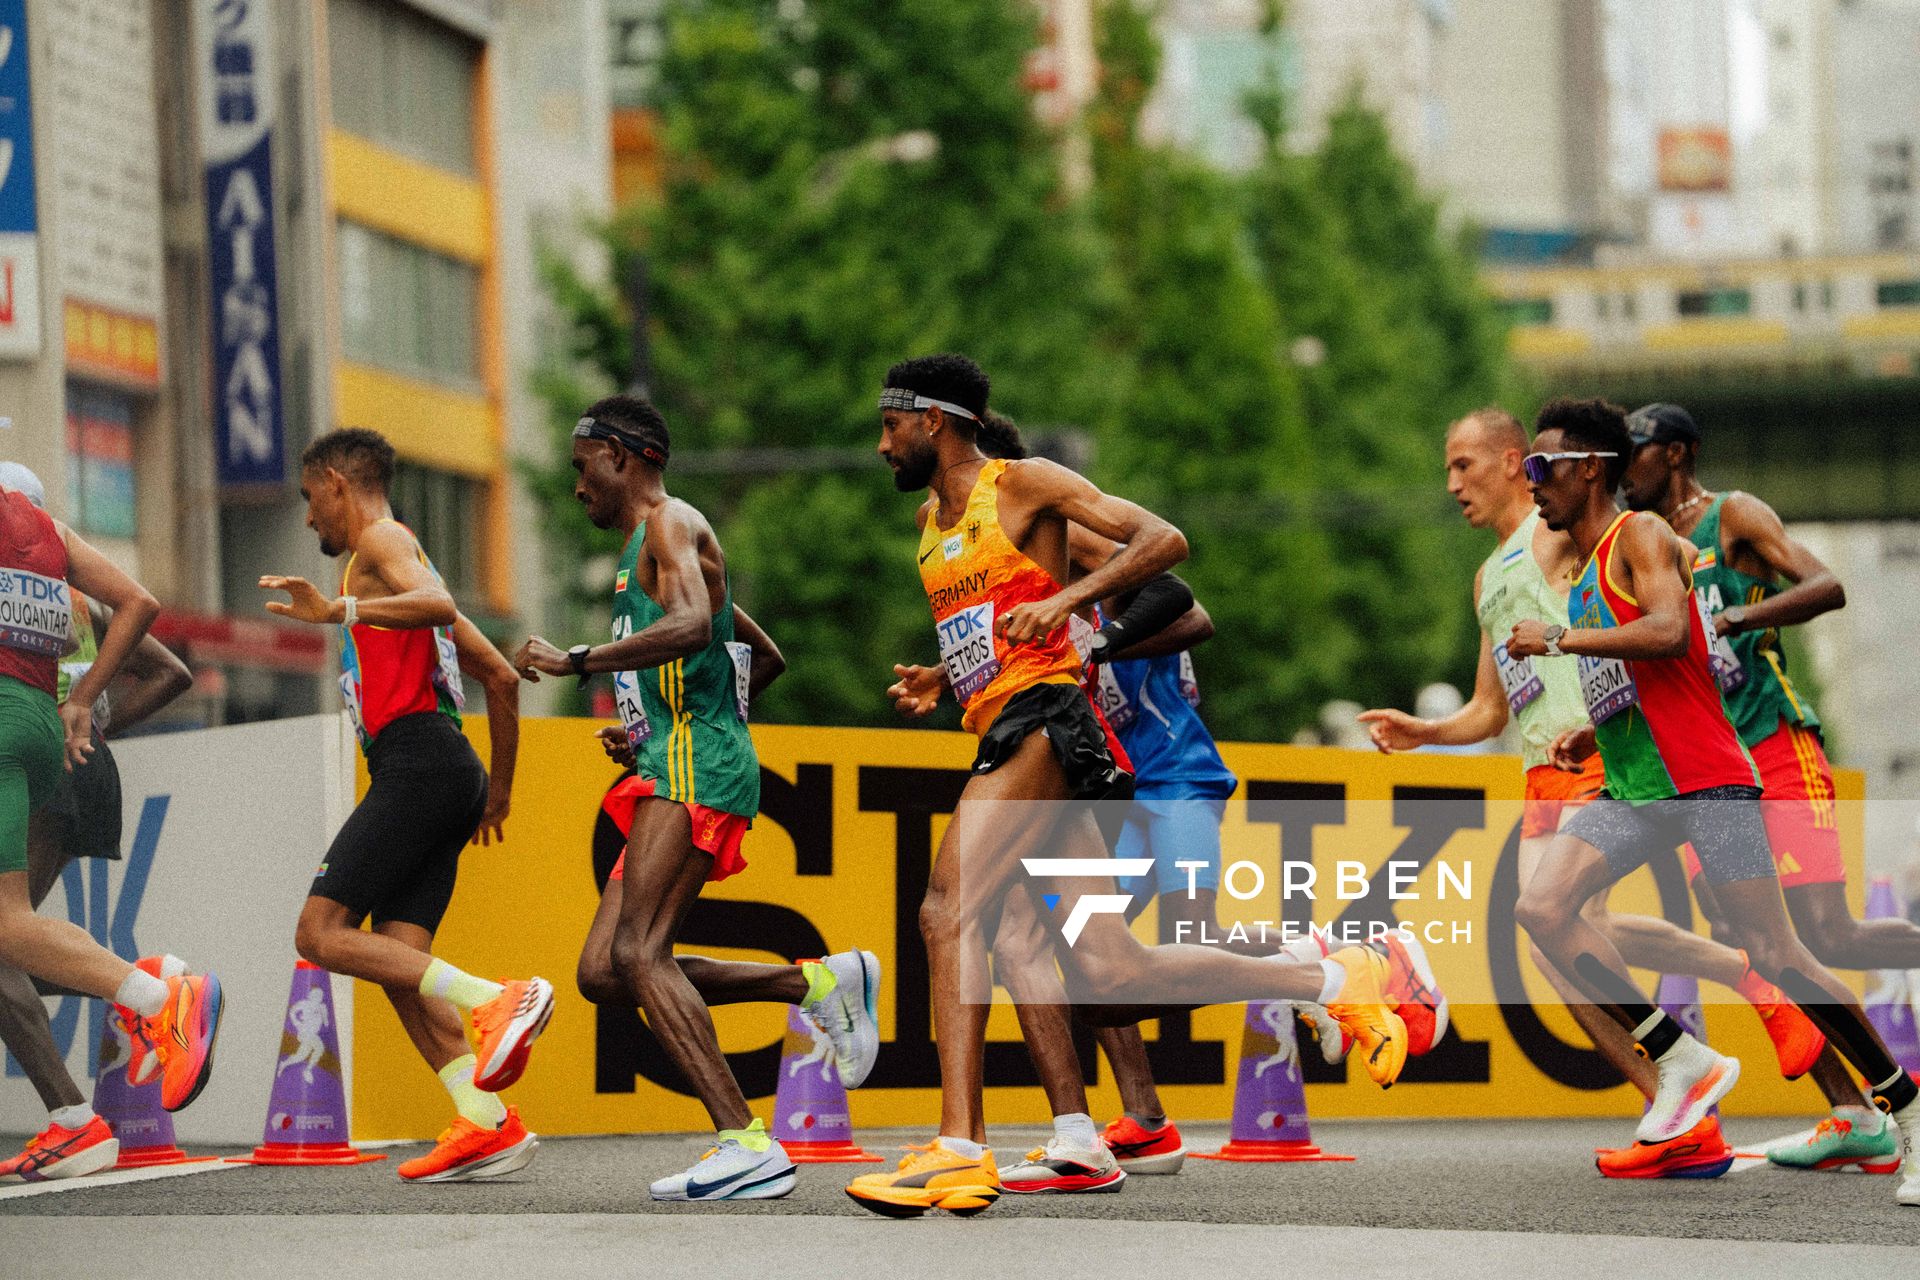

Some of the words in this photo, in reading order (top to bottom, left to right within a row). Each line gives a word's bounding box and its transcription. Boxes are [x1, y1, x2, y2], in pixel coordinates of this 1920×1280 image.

[13, 573, 66, 606] TDK
[929, 569, 989, 614] GERMANY
[0, 600, 69, 636] OUQANTAR
[940, 606, 986, 645] TDK
[943, 635, 990, 680] ETROS
[1582, 662, 1625, 706] UESOM
[1592, 690, 1634, 721] TOKYO25
